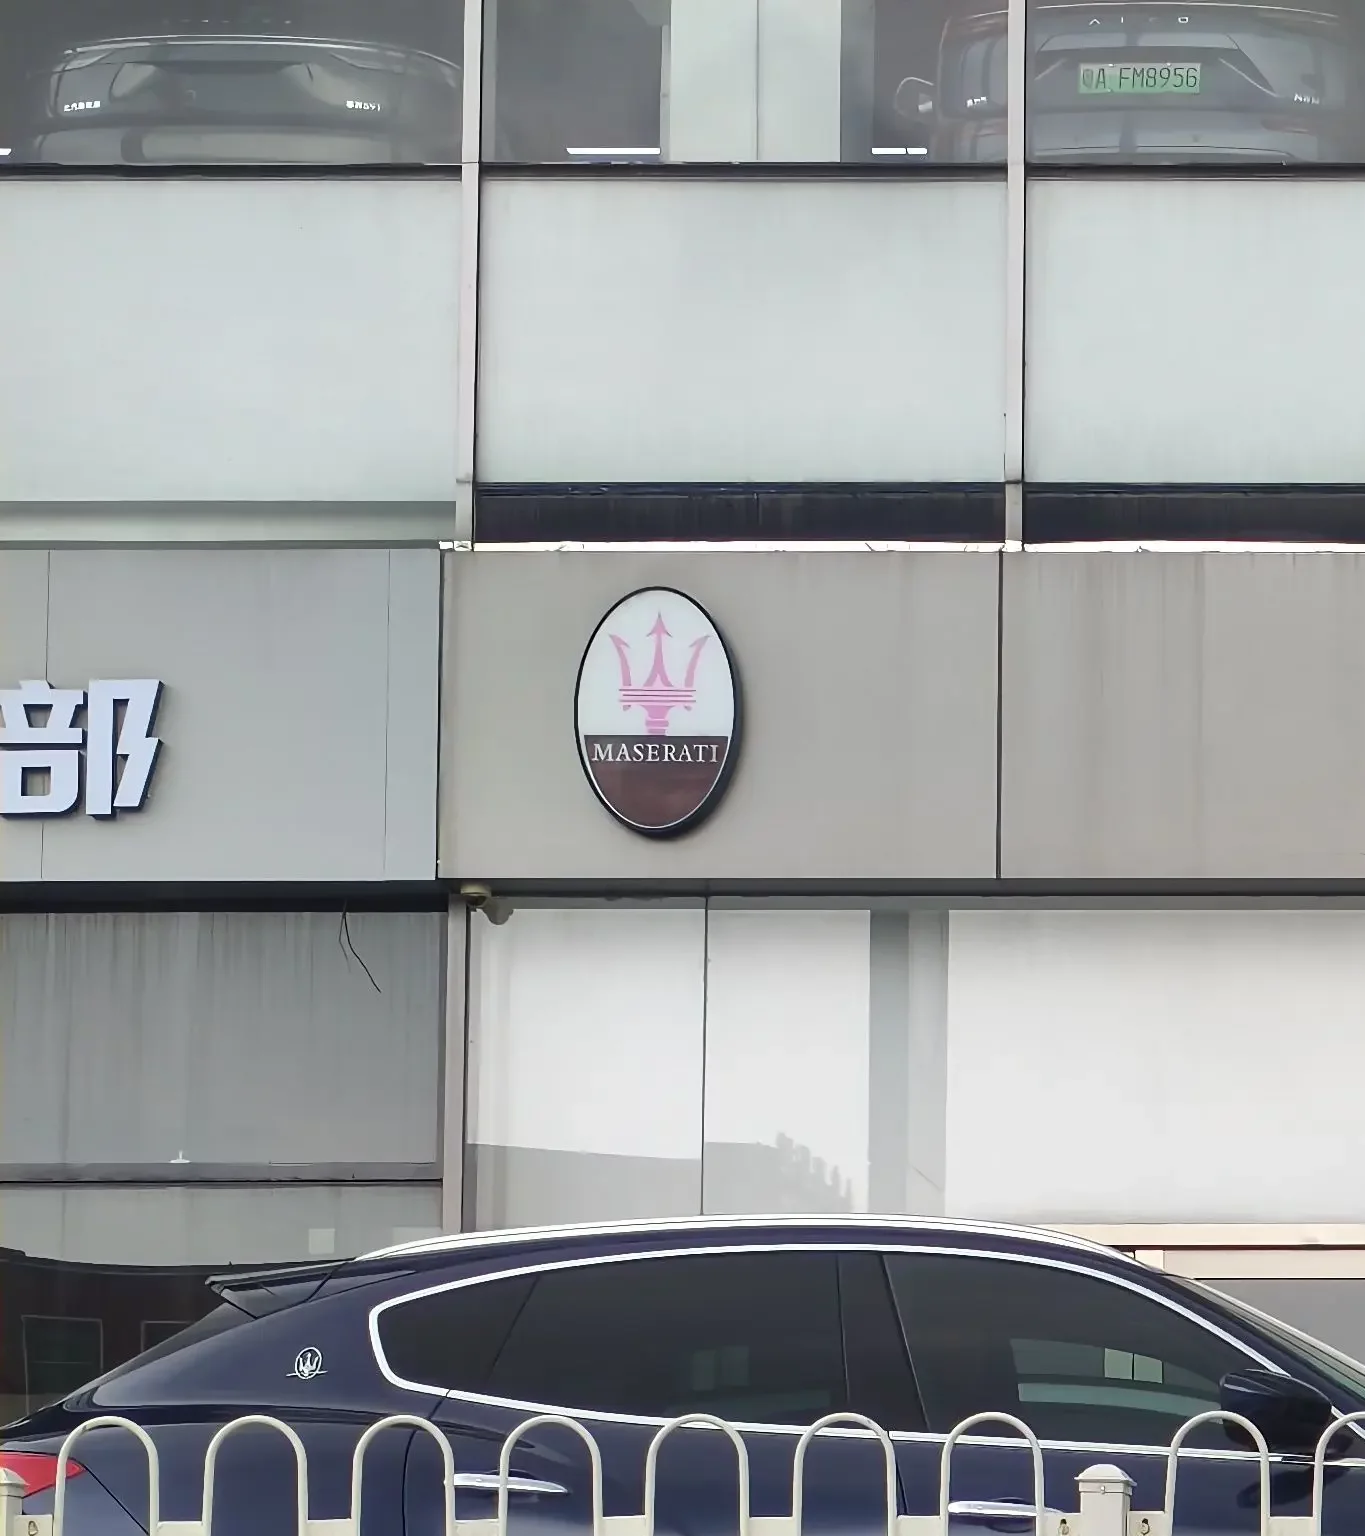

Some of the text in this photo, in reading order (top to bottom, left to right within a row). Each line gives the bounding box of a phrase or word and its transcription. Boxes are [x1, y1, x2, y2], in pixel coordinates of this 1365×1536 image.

[1118, 66, 1199, 90] FM8956
[0, 679, 166, 819] 部
[591, 743, 719, 763] MASERATI
